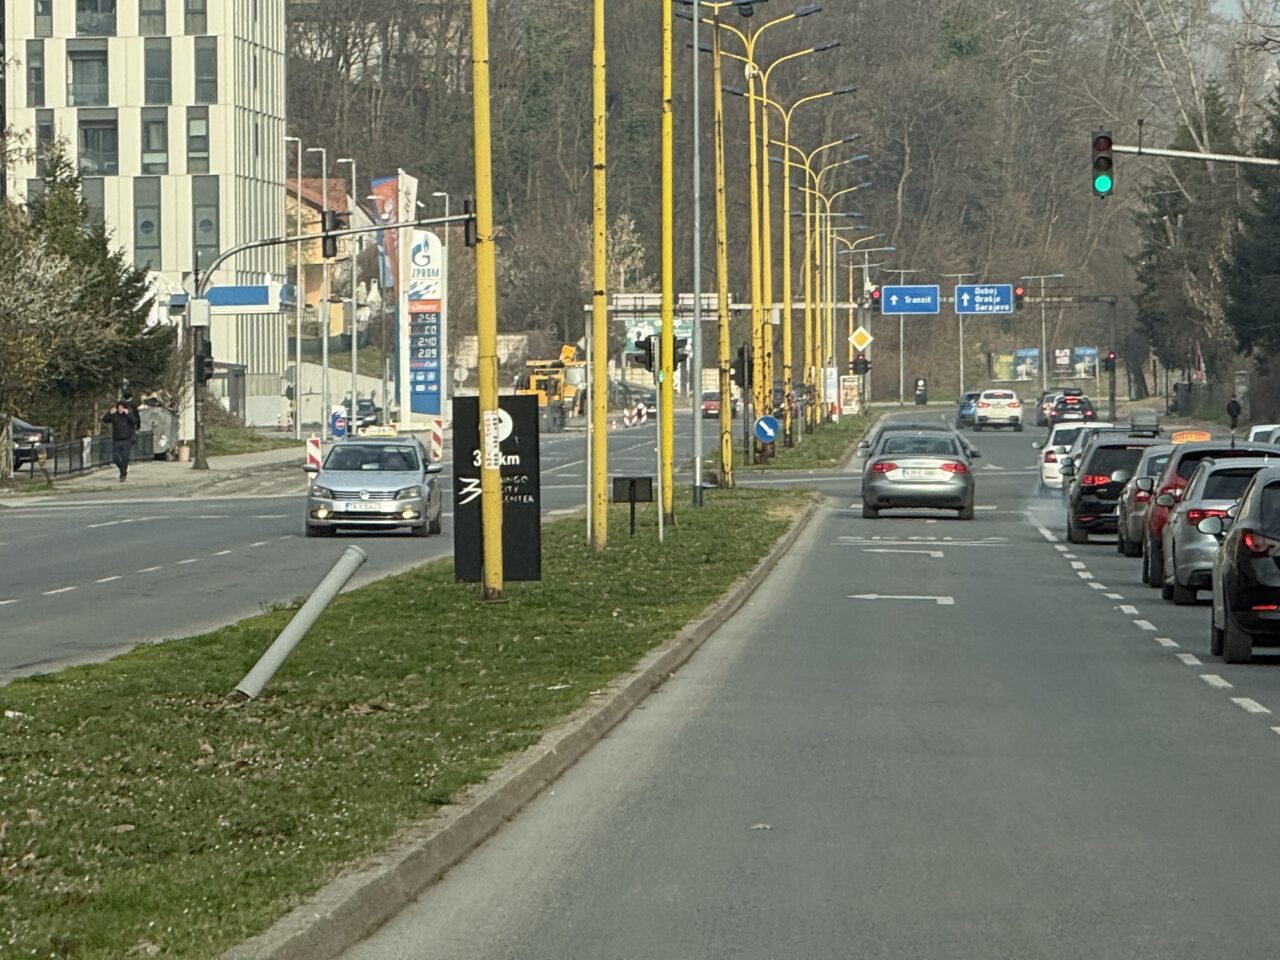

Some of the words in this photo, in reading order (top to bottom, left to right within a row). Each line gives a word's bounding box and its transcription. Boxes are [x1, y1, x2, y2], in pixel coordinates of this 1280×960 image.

[975, 287, 997, 295] Doboj
[904, 296, 931, 304] Tranzit
[975, 303, 1010, 313] Sarajevo
[502, 494, 535, 504] ENTER
